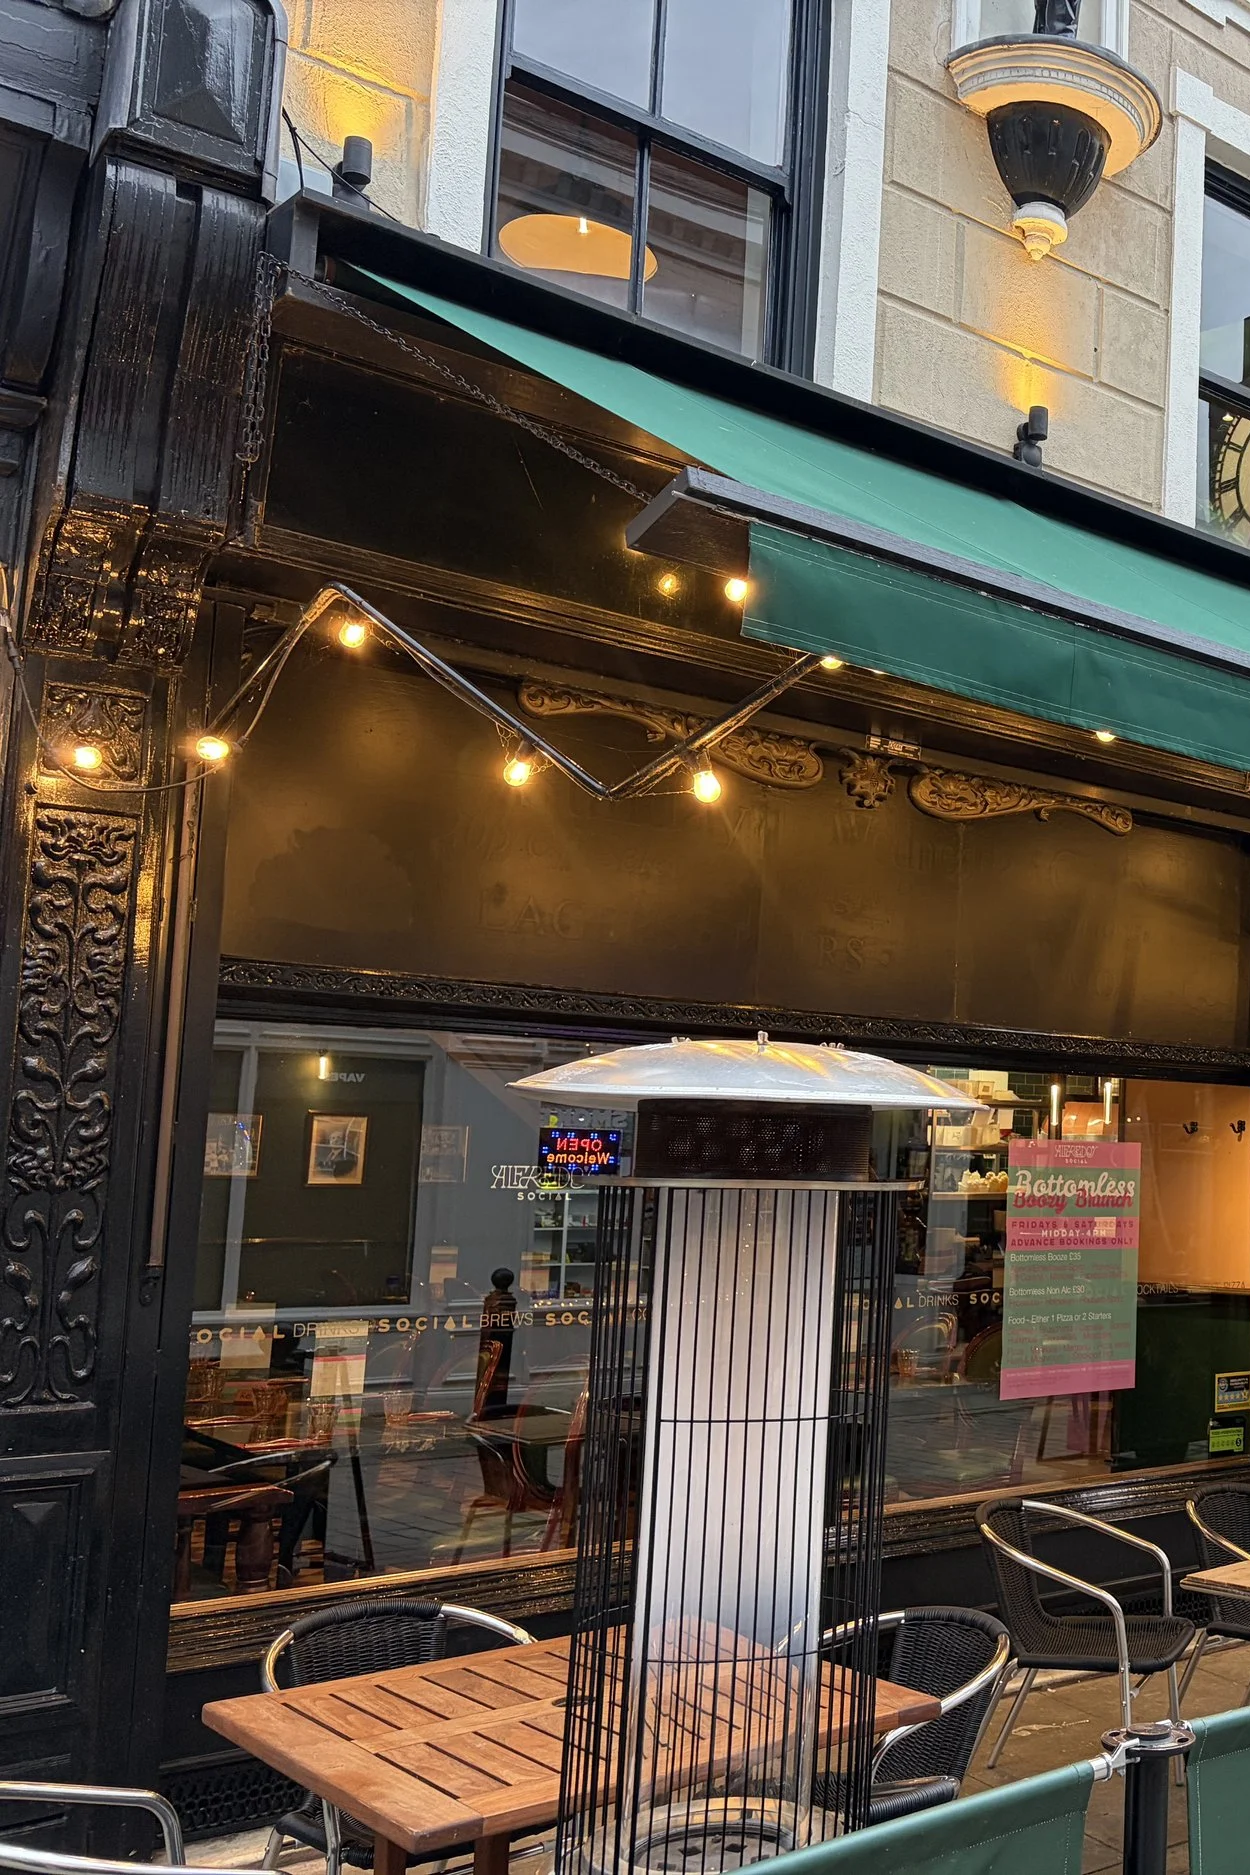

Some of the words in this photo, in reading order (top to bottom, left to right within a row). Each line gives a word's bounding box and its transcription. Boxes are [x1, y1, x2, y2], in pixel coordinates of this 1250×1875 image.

[1014, 1169, 1136, 1198] Bottomless
[517, 1191, 572, 1201] SOCIAL
[1012, 1190, 1068, 1215] Boozy
[1075, 1188, 1133, 1210] Brunch
[1011, 1220, 1058, 1230] FRIDAYS
[1074, 1219, 1135, 1230] SATURDAYS
[1041, 1229, 1107, 1238] MIDDAY-4PM
[1011, 1238, 1056, 1247] ADVANCE
[1059, 1237, 1107, 1247] BOOKINGS
[1111, 1236, 1134, 1246] ONLY
[1010, 1253, 1048, 1262] Bottomless
[1048, 1252, 1069, 1261] Booze
[1068, 1252, 1083, 1261] £35
[1009, 1287, 1046, 1296] Bottomless
[1046, 1286, 1060, 1295] Non
[1061, 1285, 1072, 1294] Alc
[918, 1293, 960, 1308] DRINKS
[378, 1315, 473, 1333] SOCIAL
[479, 1311, 534, 1329] BREWS
[1008, 1315, 1026, 1325] Food
[1031, 1314, 1050, 1324] Either
[1056, 1313, 1073, 1323] Pizza
[1082, 1312, 1087, 1321] 2
[1088, 1311, 1112, 1320] Starters
